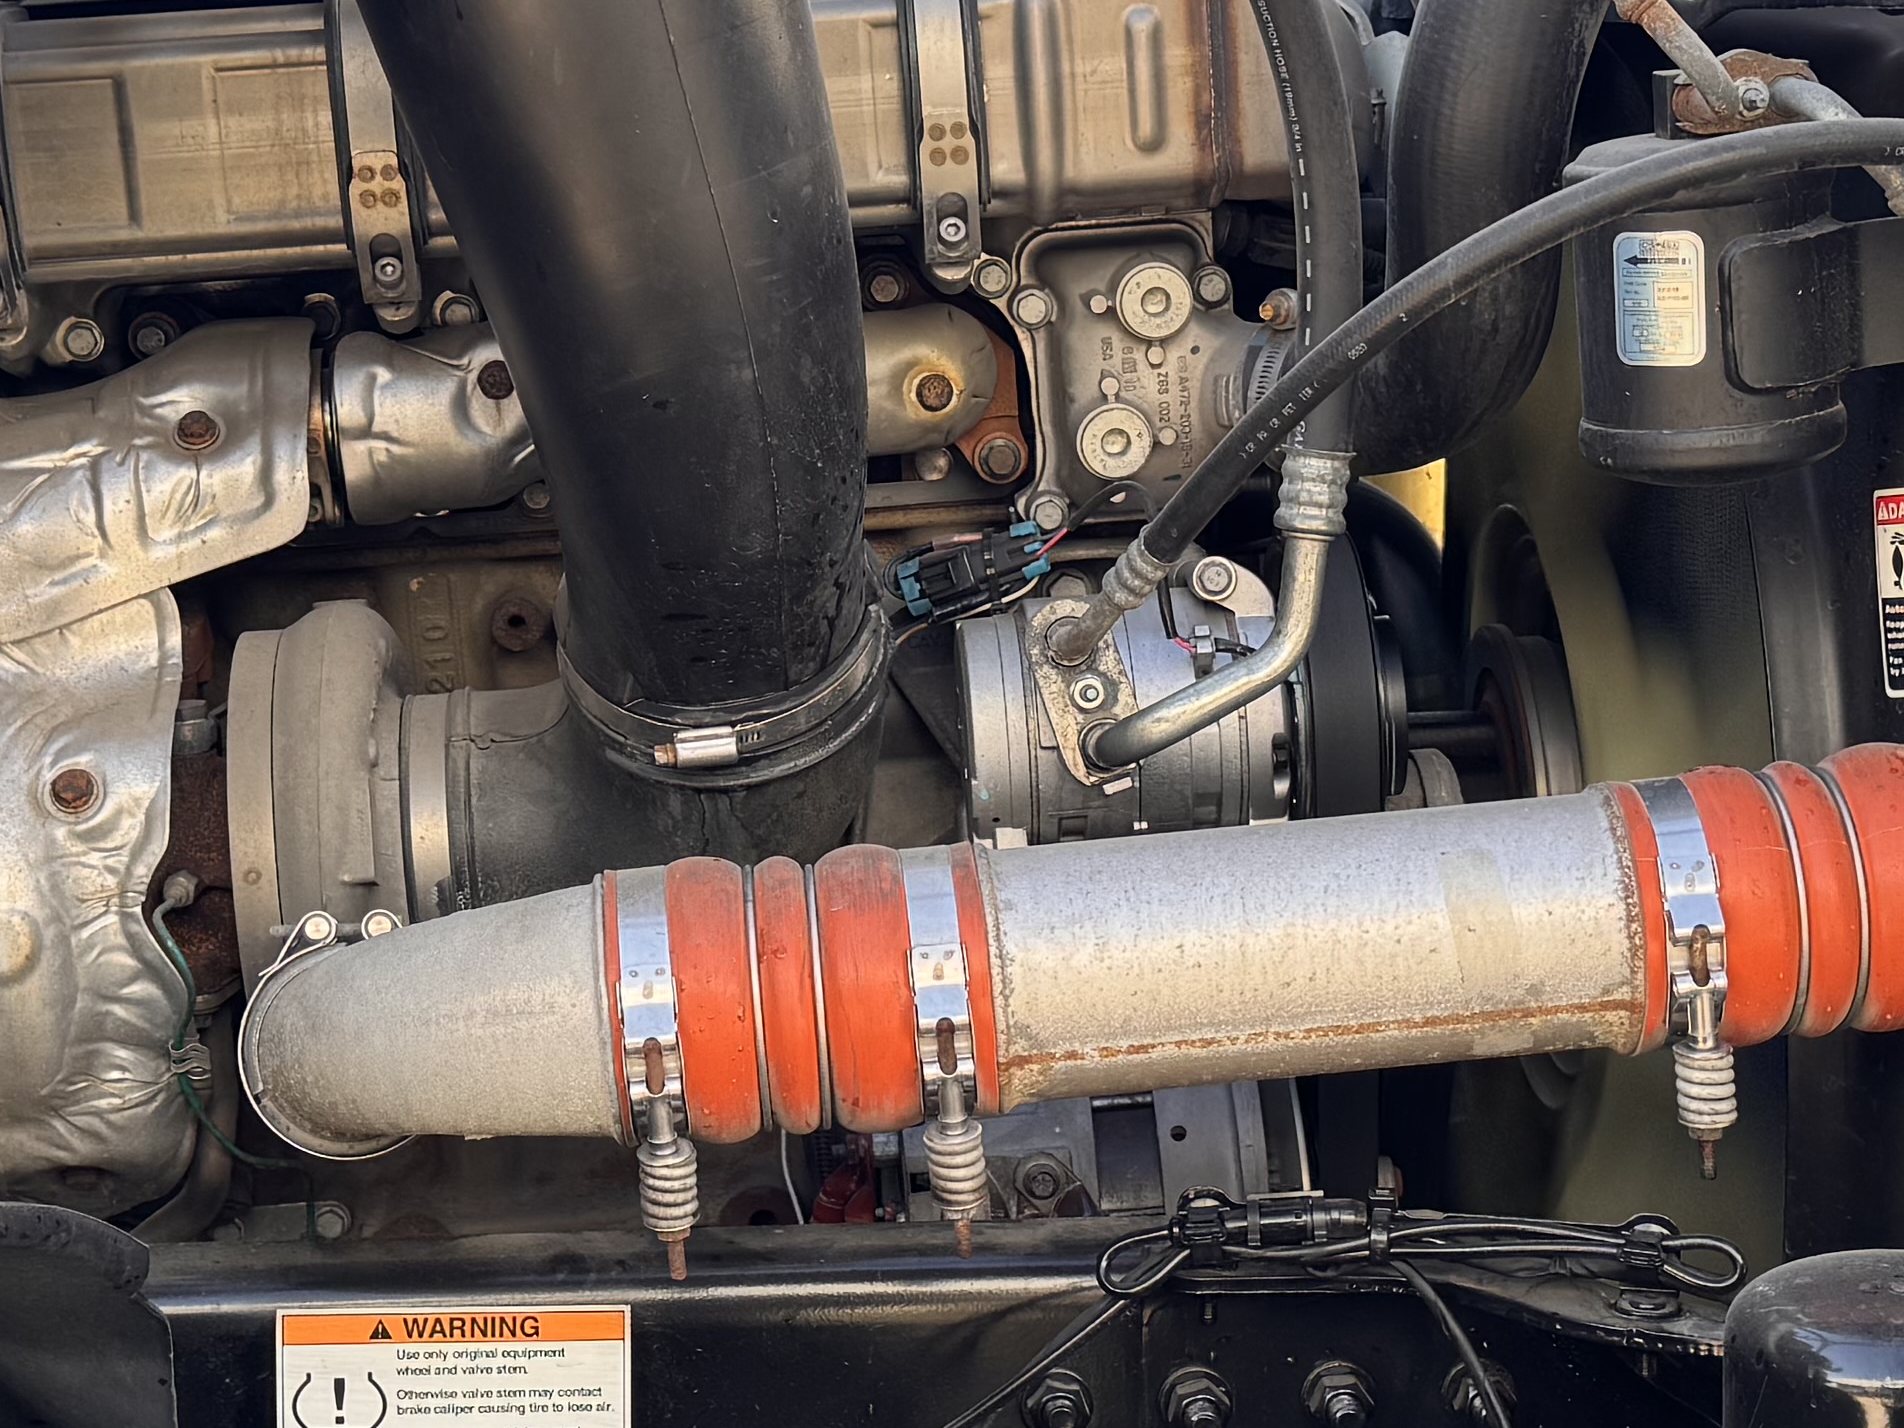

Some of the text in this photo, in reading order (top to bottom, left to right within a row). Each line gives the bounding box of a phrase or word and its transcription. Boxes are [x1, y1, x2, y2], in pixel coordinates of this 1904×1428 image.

[1273, 48, 1289, 80] HOSE
[1281, 81, 1298, 122] (19mm)
[1100, 335, 1114, 363] USA
[1889, 655, 1904, 666] Fan
[1889, 668, 1901, 679] by
[402, 1315, 541, 1340] WARNING
[396, 1347, 566, 1362] Use only original equipment
[396, 1364, 431, 1376] wheel
[434, 1364, 458, 1376] and
[461, 1364, 494, 1375] valve
[397, 1387, 603, 1400] Otherwise valve stem may contact
[397, 1401, 615, 1416] brake caliper causing tire to lose air.
